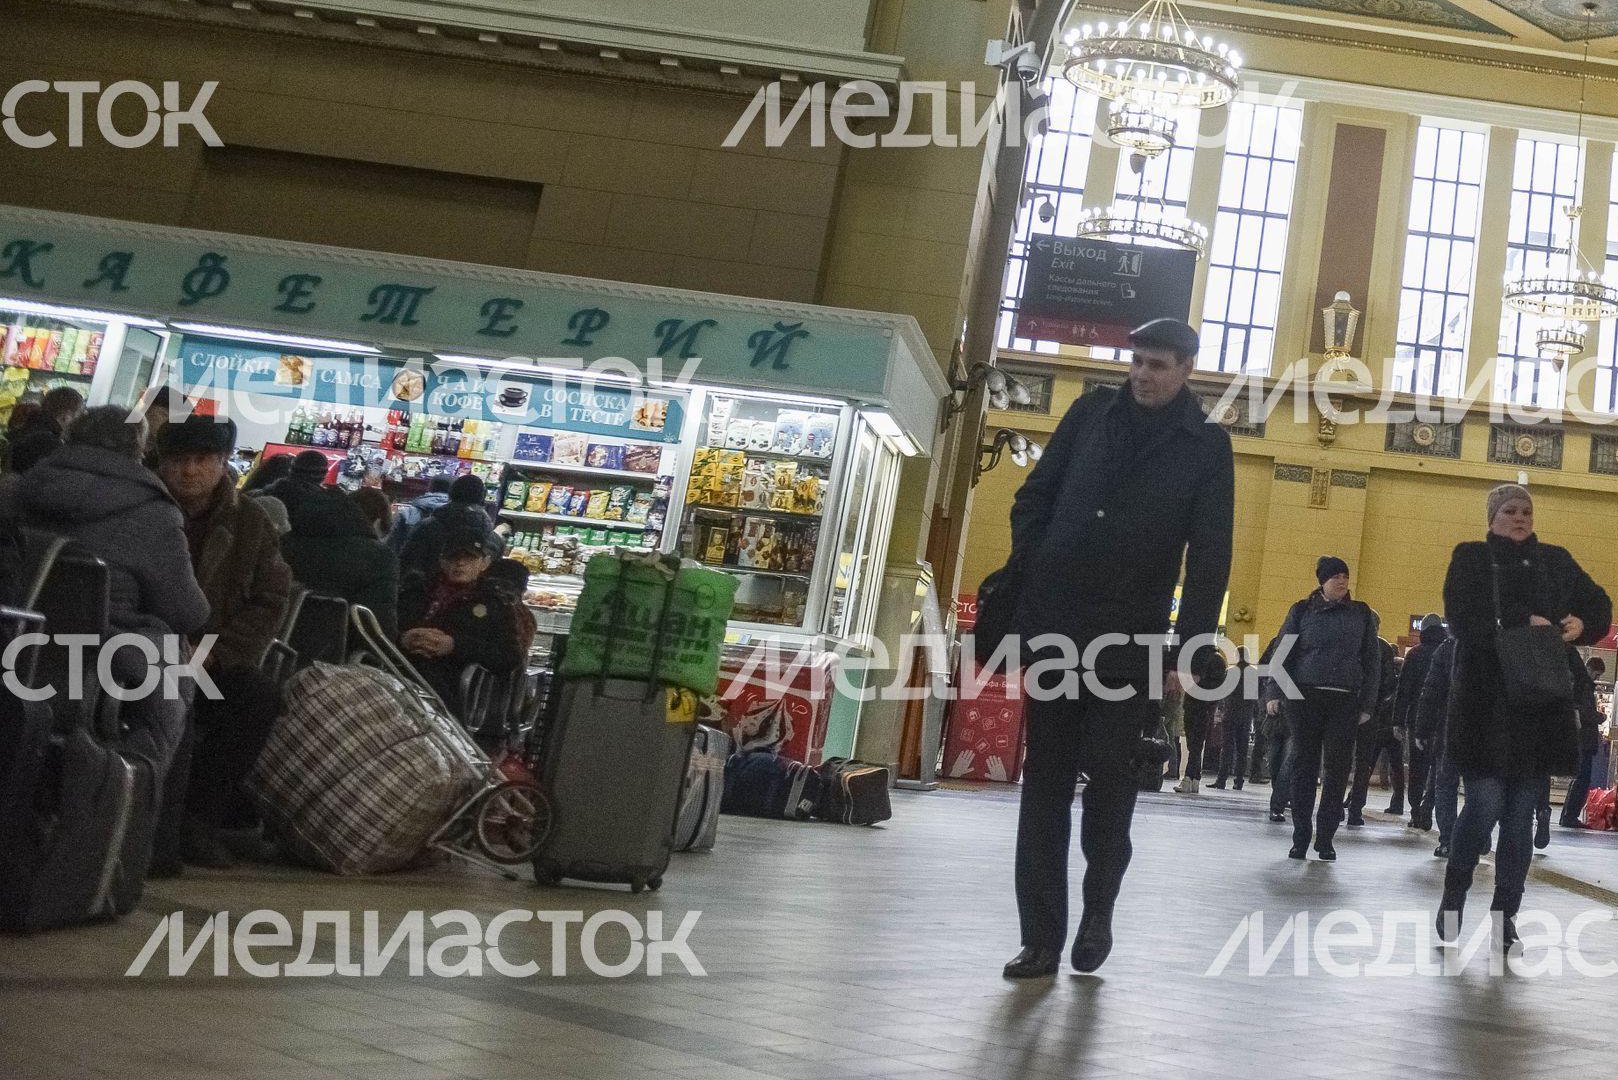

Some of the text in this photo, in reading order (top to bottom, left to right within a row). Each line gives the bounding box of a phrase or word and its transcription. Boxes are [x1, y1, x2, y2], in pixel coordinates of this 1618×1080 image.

[1053, 241, 1107, 262] Выход
[1051, 257, 1076, 270] Exit
[190, 351, 271, 376] СЛОЙКИ
[319, 367, 384, 390] САМСА
[432, 390, 485, 412] КОФЕ
[542, 386, 630, 413] СОСИСКА
[540, 402, 627, 427] В ТЕСТЕ
